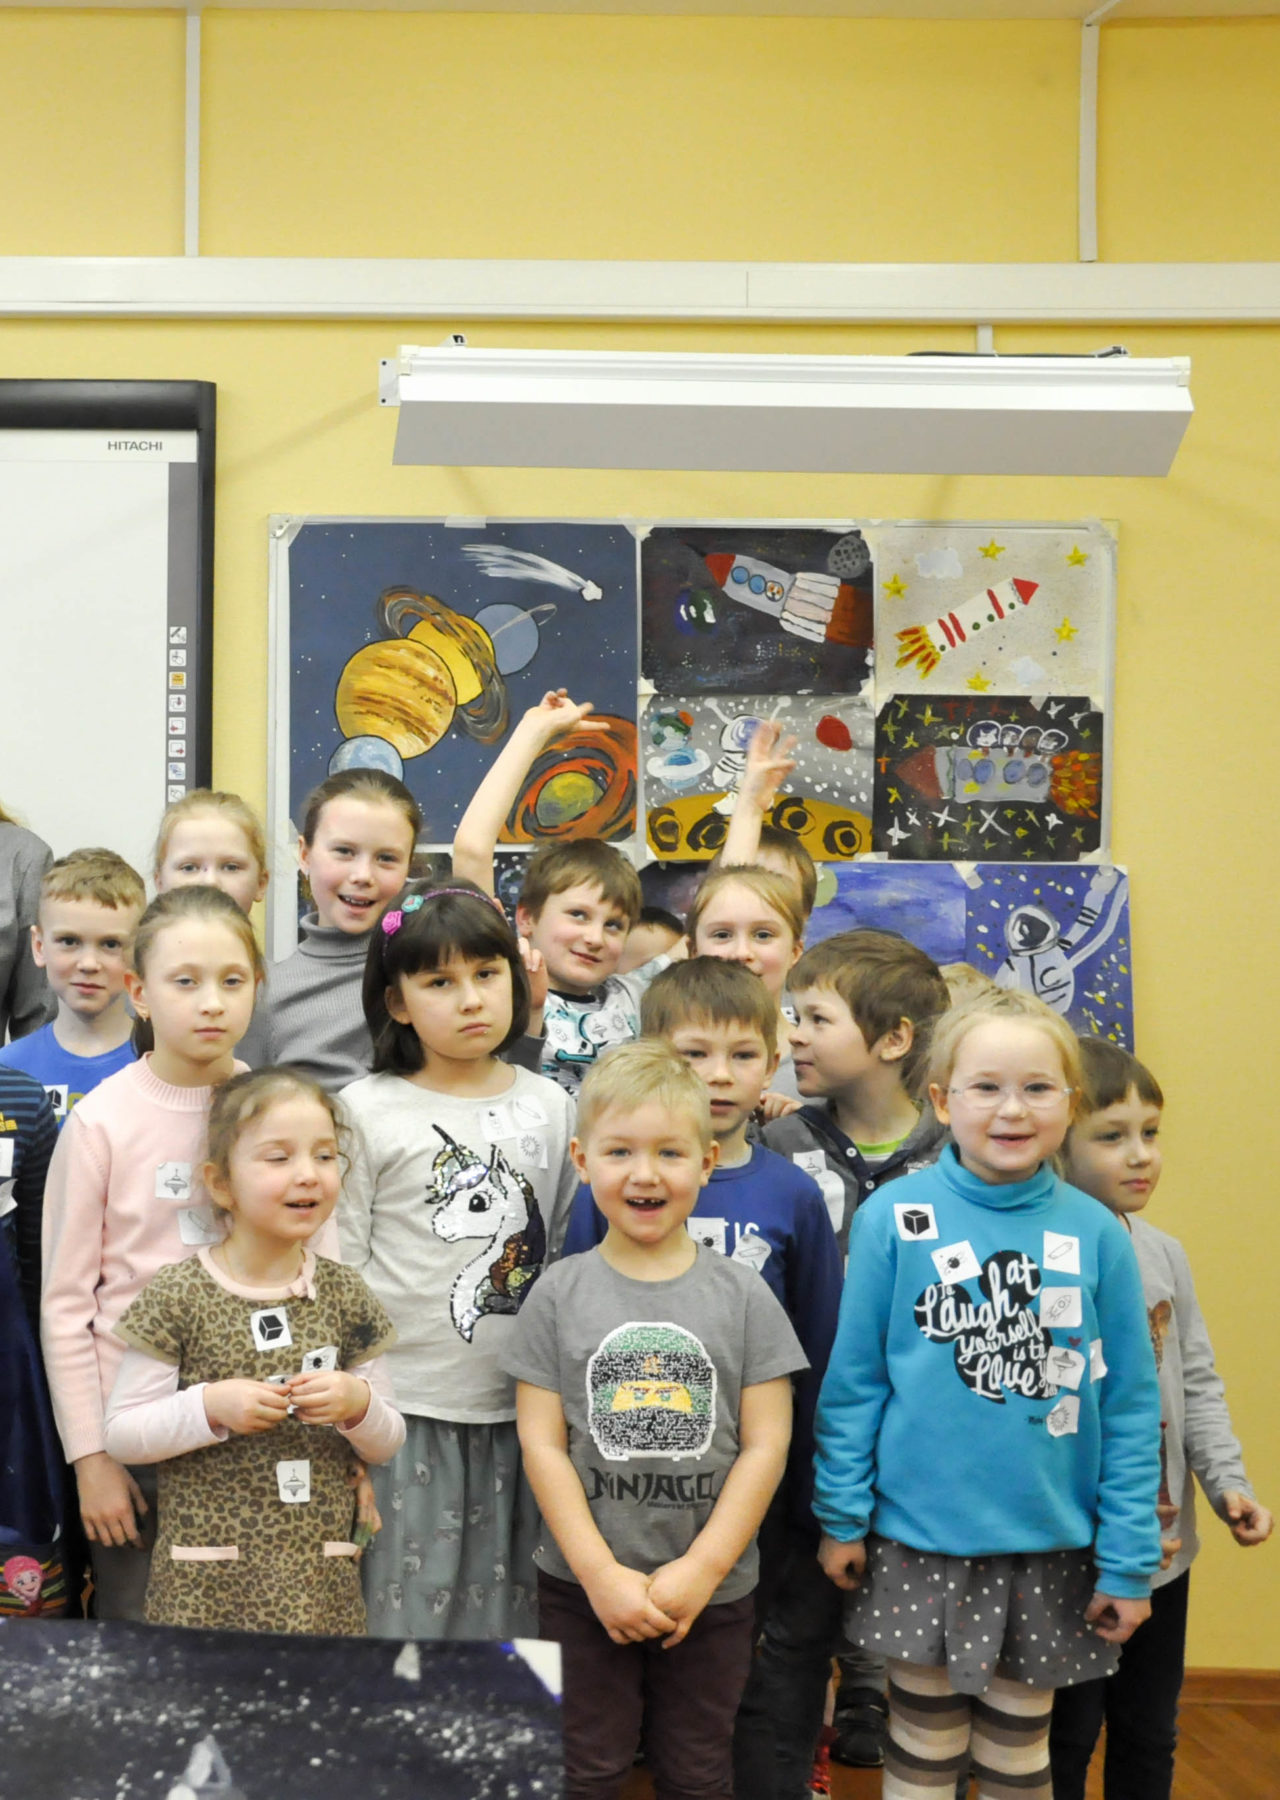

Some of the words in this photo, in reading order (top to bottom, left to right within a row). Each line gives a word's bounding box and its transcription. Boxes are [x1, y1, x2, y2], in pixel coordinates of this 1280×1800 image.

[107, 441, 163, 451] HITACHI
[1006, 1253, 1041, 1296] at
[587, 1467, 719, 1506] NINJAGO
